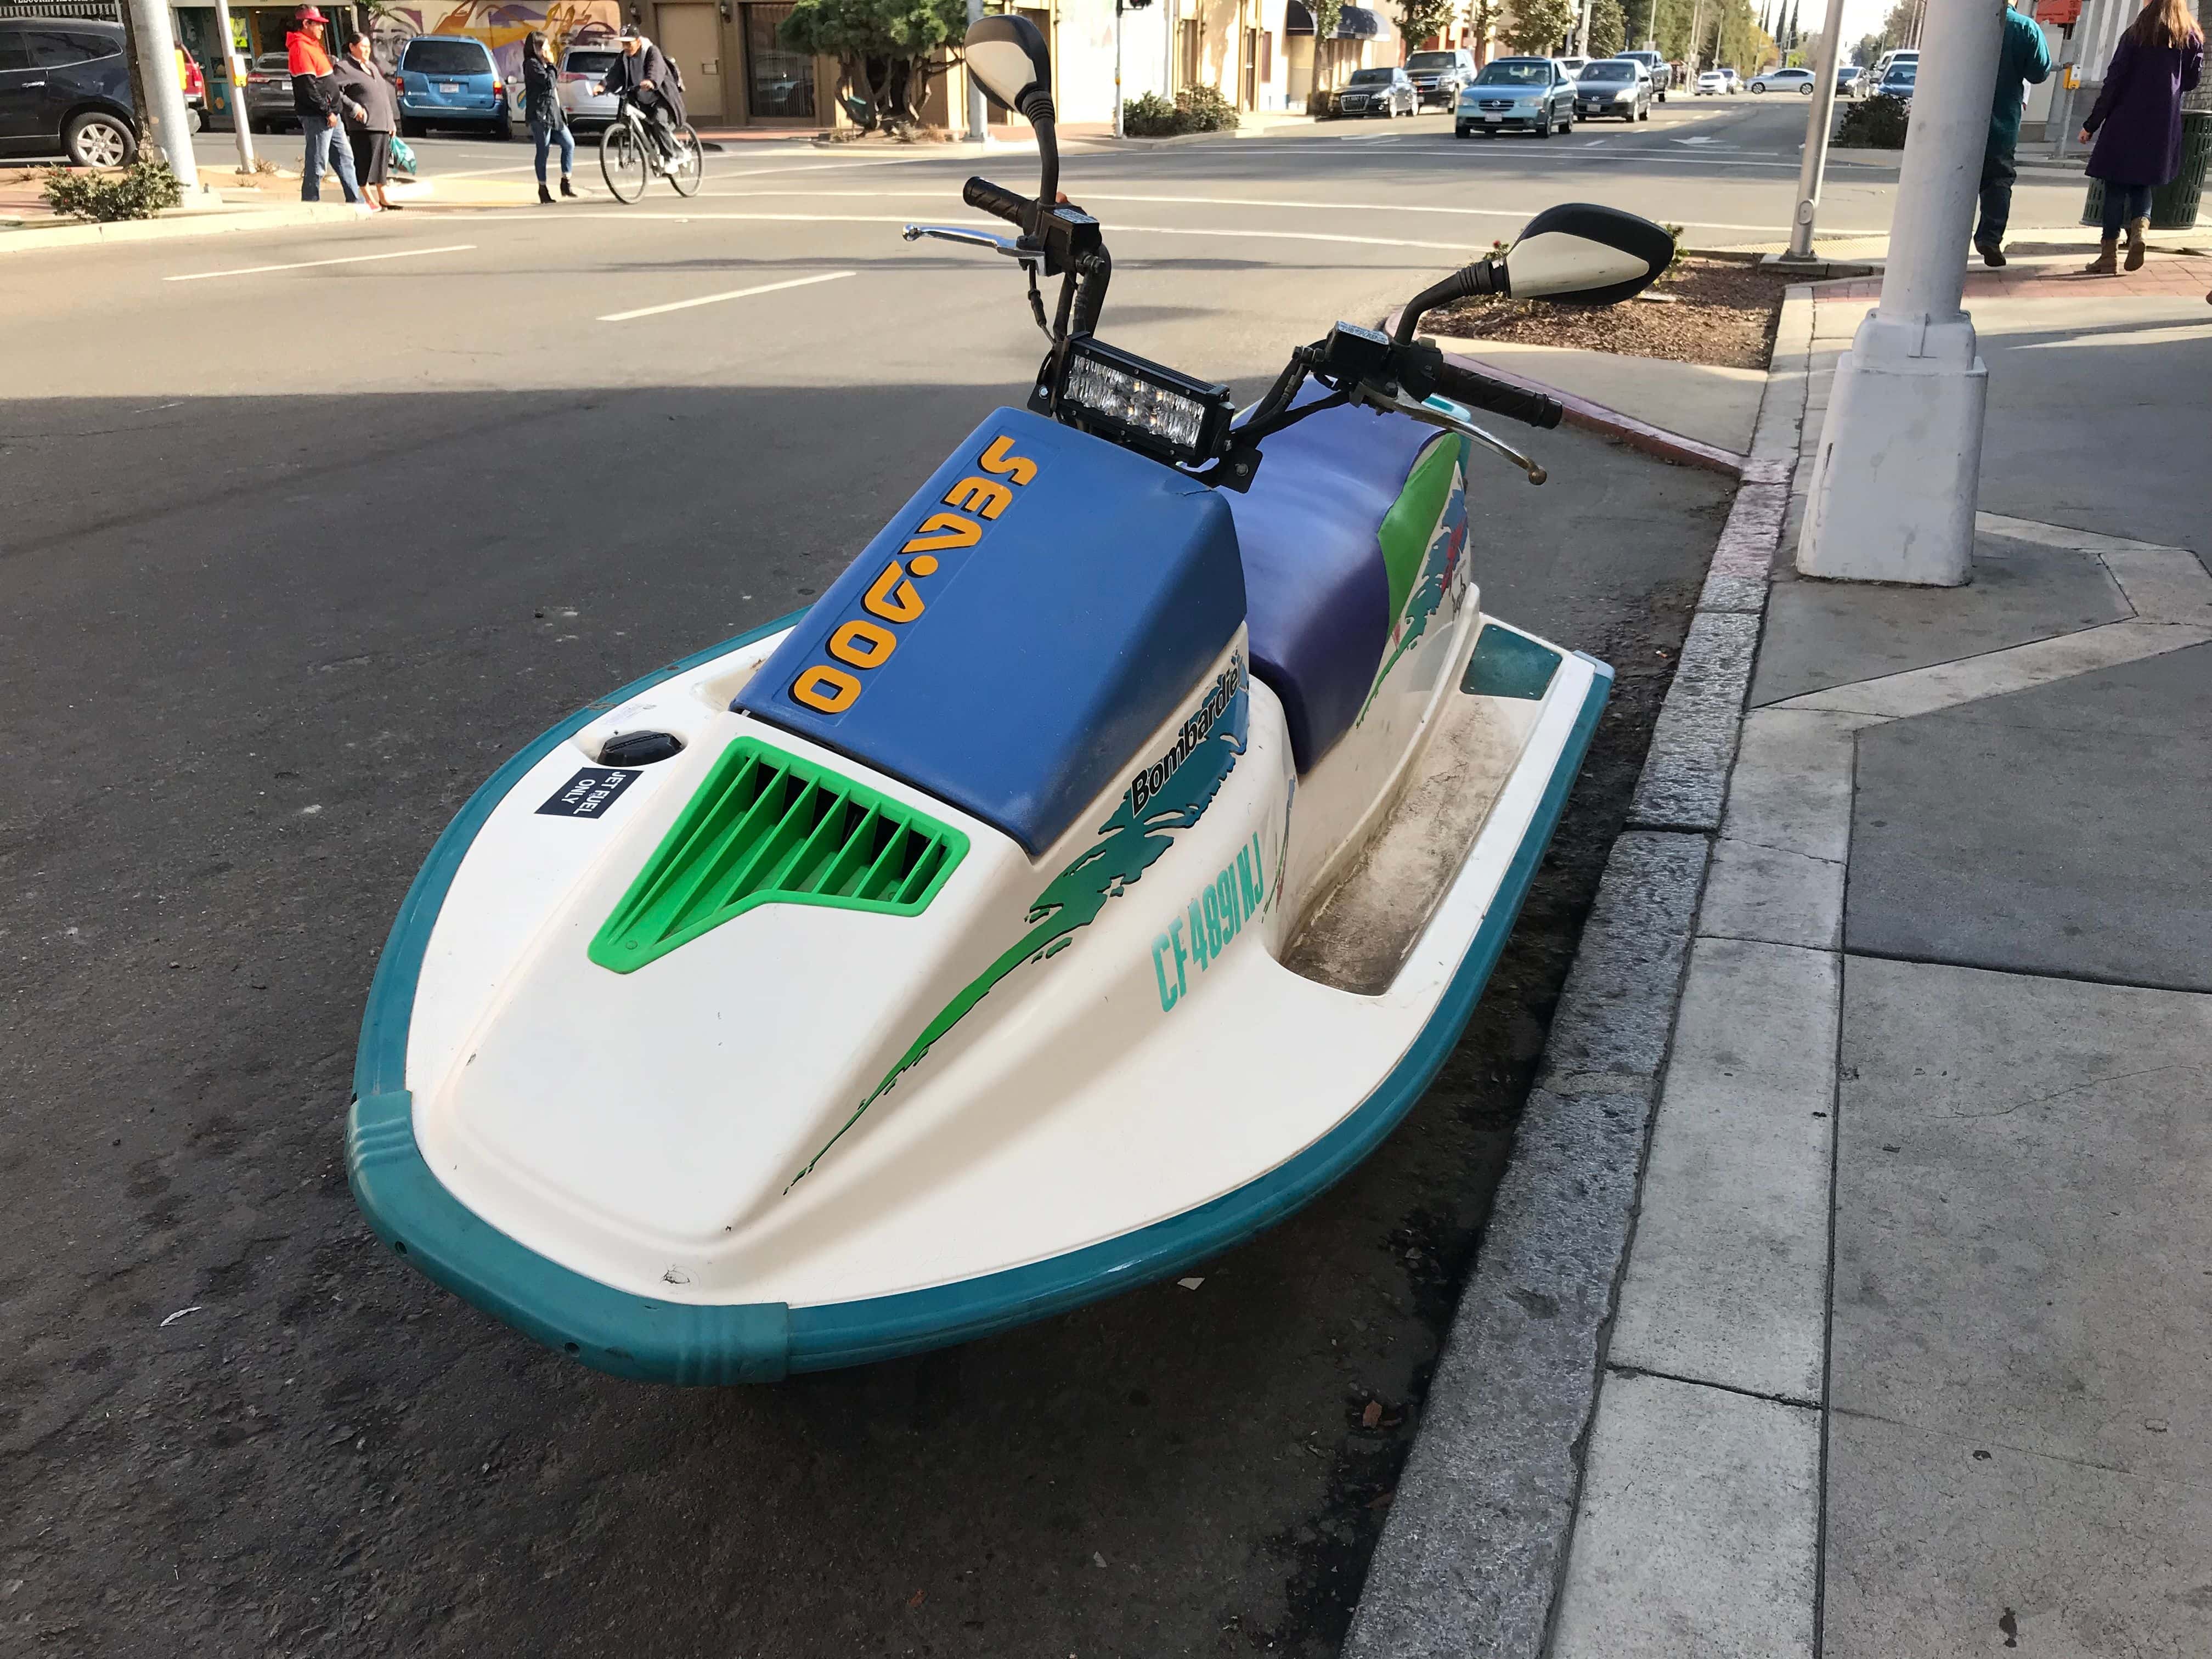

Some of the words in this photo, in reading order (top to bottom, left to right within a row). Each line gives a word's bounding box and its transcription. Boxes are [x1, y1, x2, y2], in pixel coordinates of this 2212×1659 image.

[561, 779, 596, 804] ONLY
[601, 771, 627, 789] JET
[573, 790, 611, 814] FUEL
[1152, 916, 1188, 1013] CF
